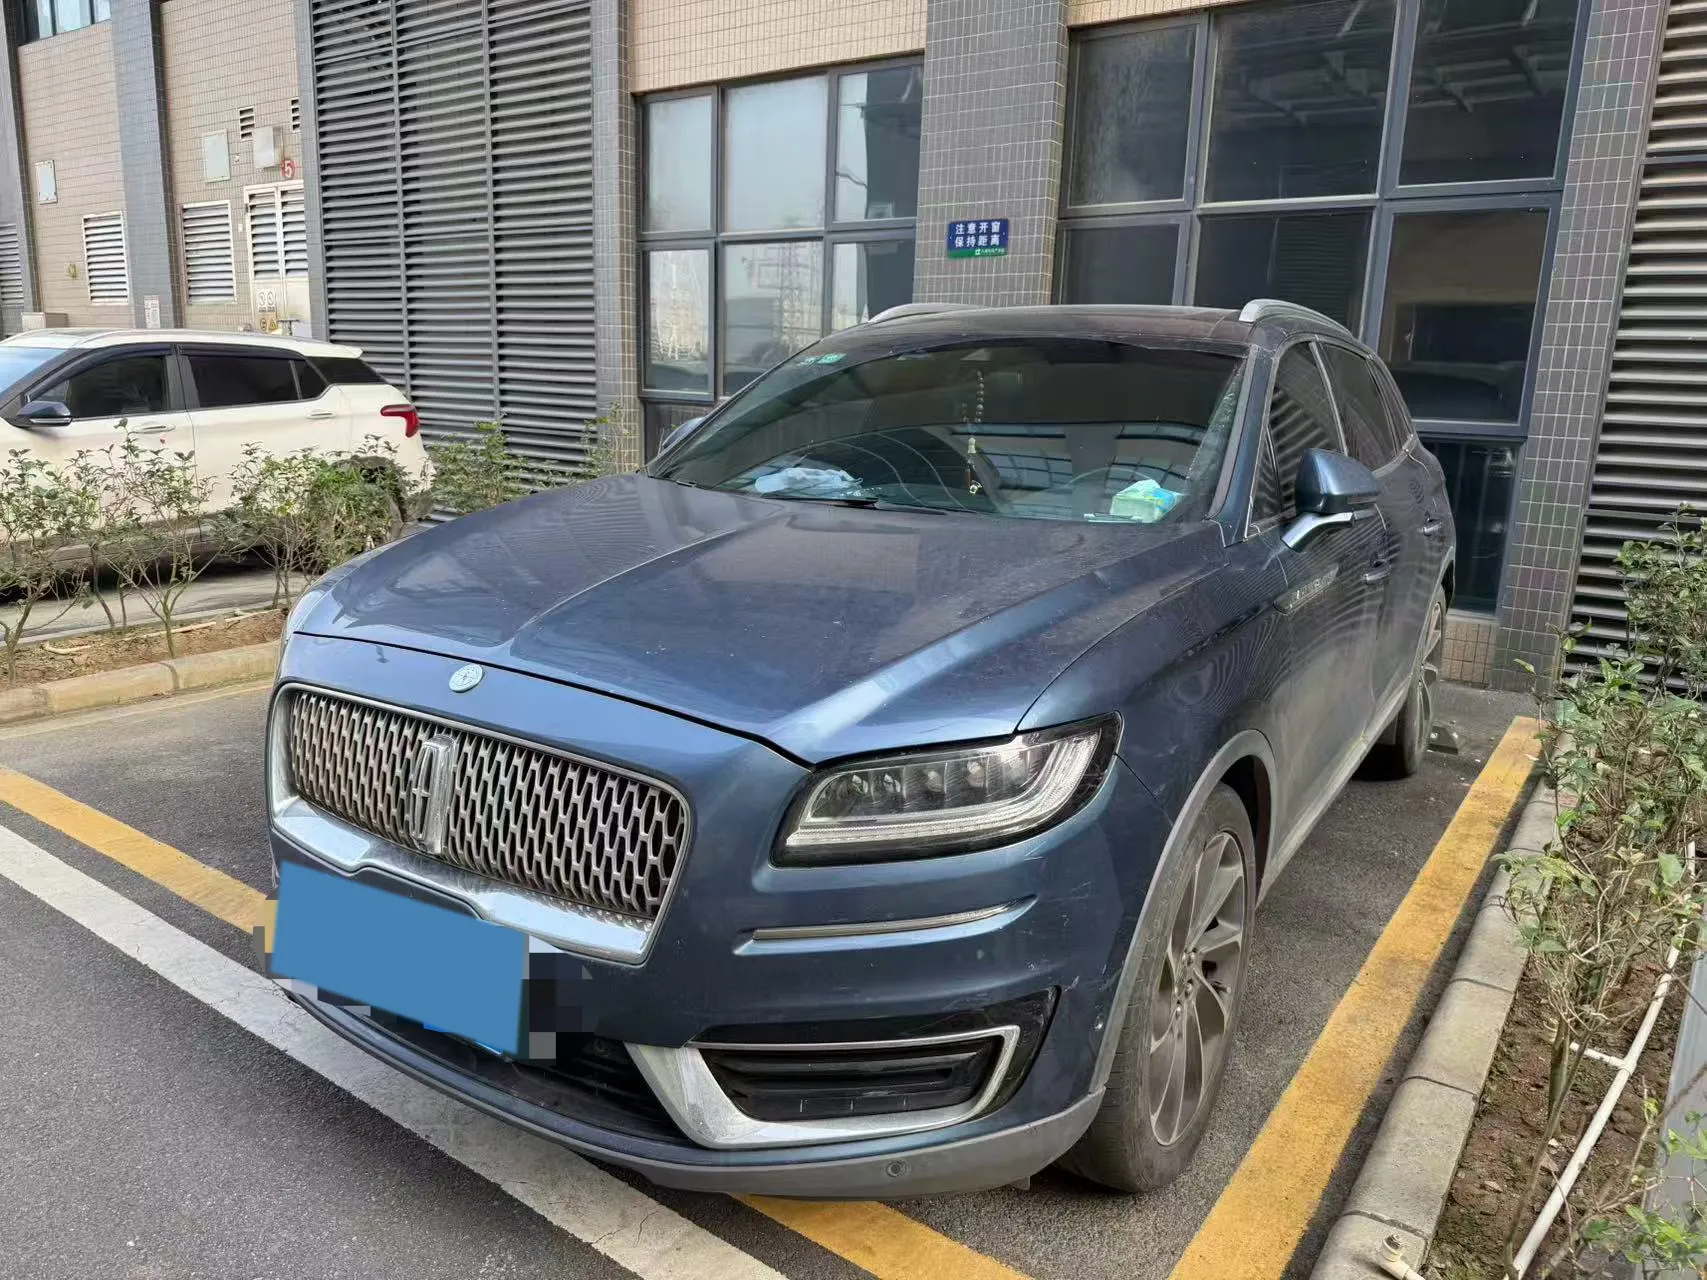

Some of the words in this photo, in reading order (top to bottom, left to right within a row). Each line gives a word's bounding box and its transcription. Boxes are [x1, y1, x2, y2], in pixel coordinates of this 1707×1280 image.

[284, 160, 293, 178] 5
[955, 221, 1001, 235] 注意开窗
[955, 234, 1000, 248] 保持距离
